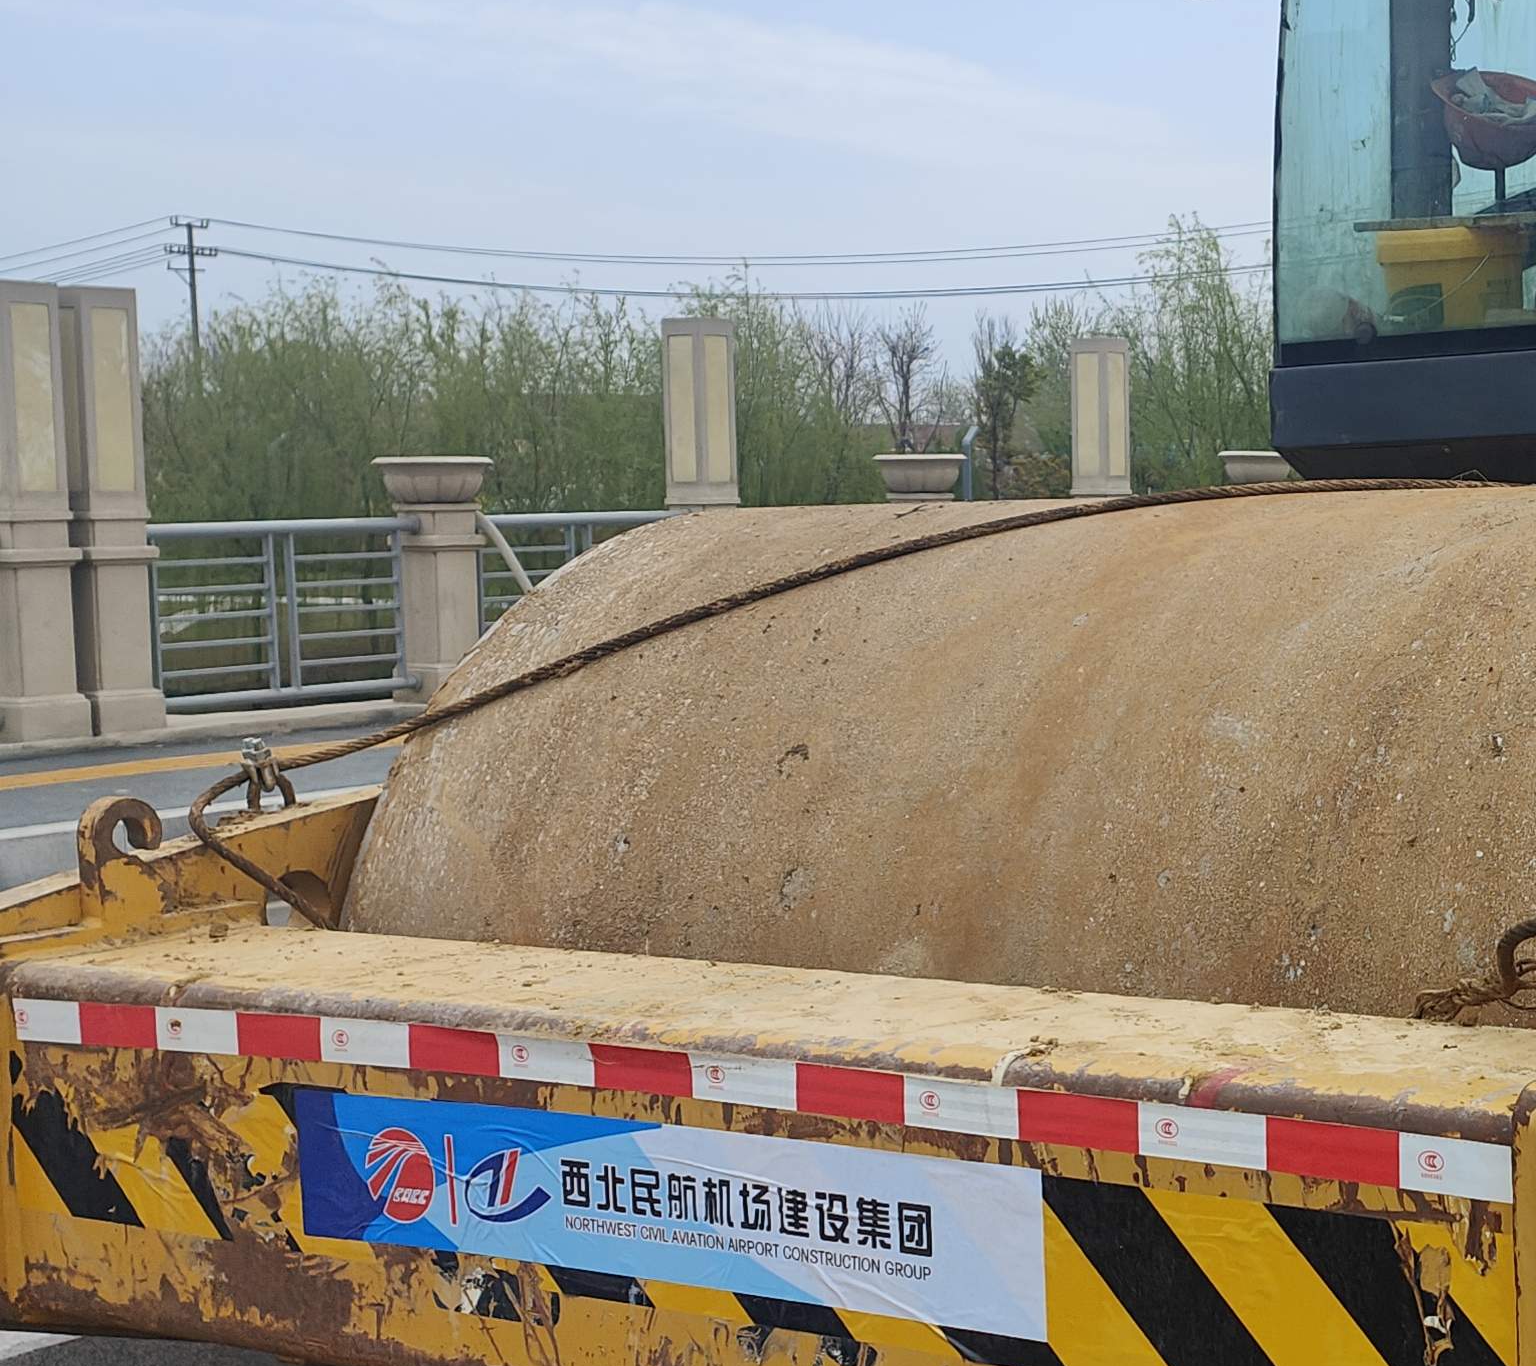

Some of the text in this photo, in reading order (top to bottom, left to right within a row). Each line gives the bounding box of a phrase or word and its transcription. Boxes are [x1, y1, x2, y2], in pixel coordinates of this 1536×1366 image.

[560, 1158, 933, 1258] 西北民航机场建设集团
[565, 1214, 932, 1281] NORTHWEST CIVIL AVIATION AIRPORT CONSTRUCTION GROUP
